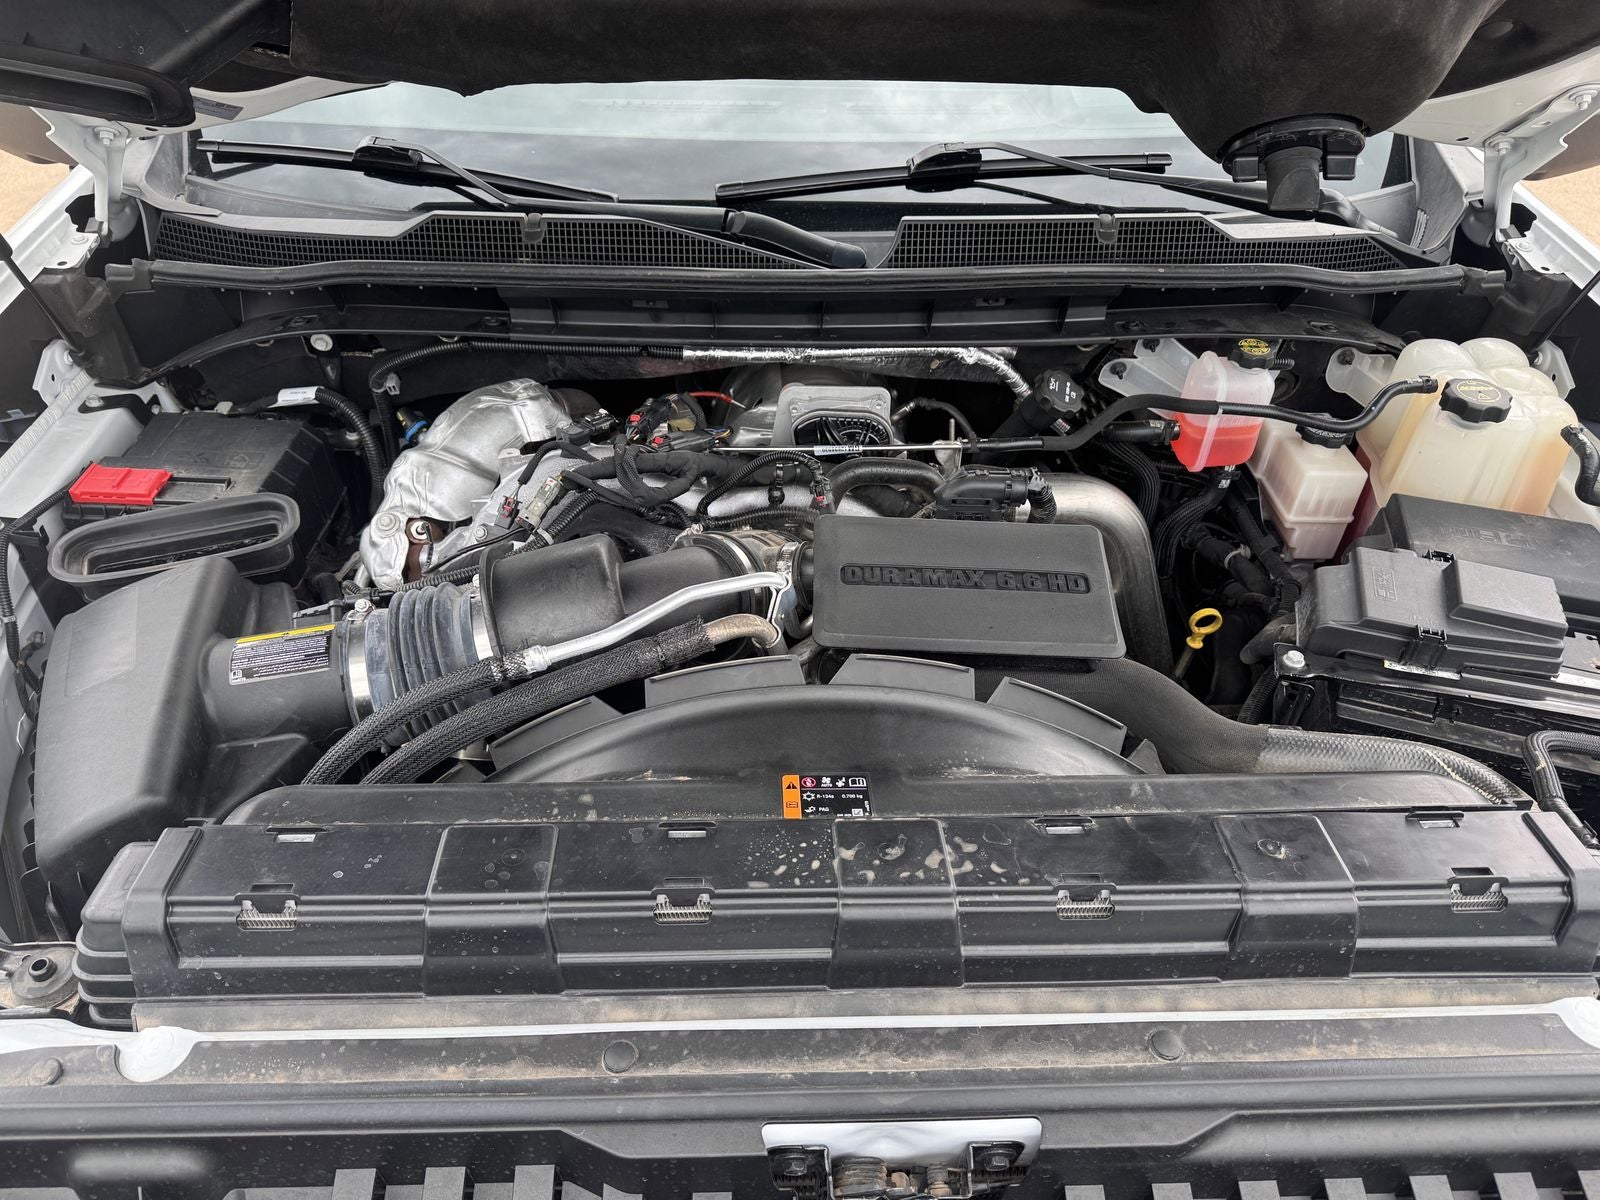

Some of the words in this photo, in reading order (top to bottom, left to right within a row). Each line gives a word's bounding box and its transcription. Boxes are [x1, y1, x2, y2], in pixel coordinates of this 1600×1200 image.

[844, 566, 986, 588] DURAMAX
[996, 571, 1042, 591] 6.6
[1047, 572, 1088, 593] HD
